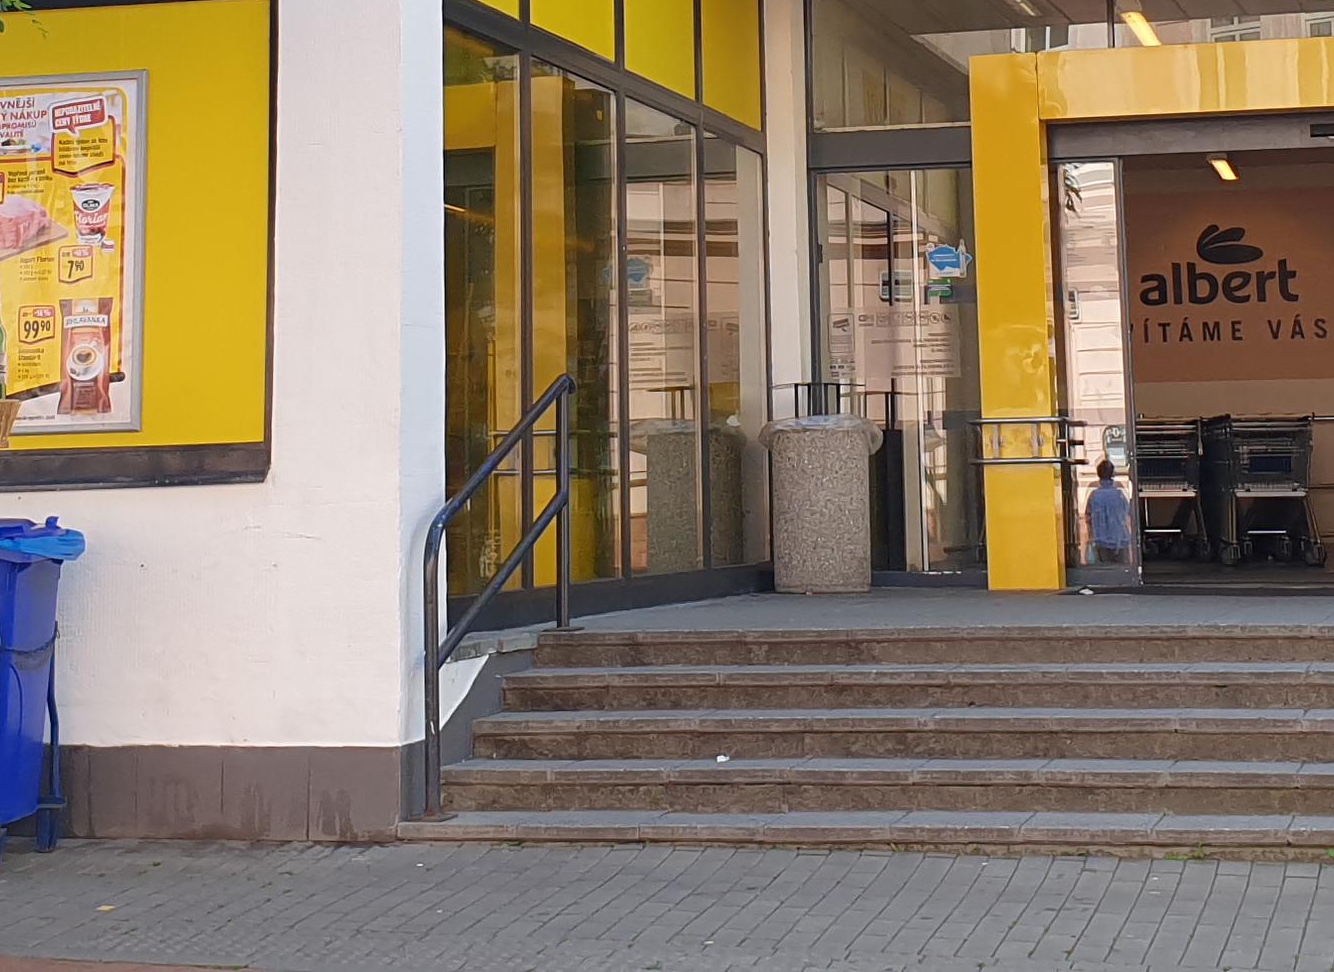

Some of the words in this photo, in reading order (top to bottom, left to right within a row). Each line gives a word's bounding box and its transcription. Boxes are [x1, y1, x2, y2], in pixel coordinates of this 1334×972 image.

[9, 109, 48, 121] NÁKUP
[1139, 258, 1300, 307] albert
[1130, 316, 1244, 344] ÍTÁME
[1266, 314, 1329, 341] VÁS
